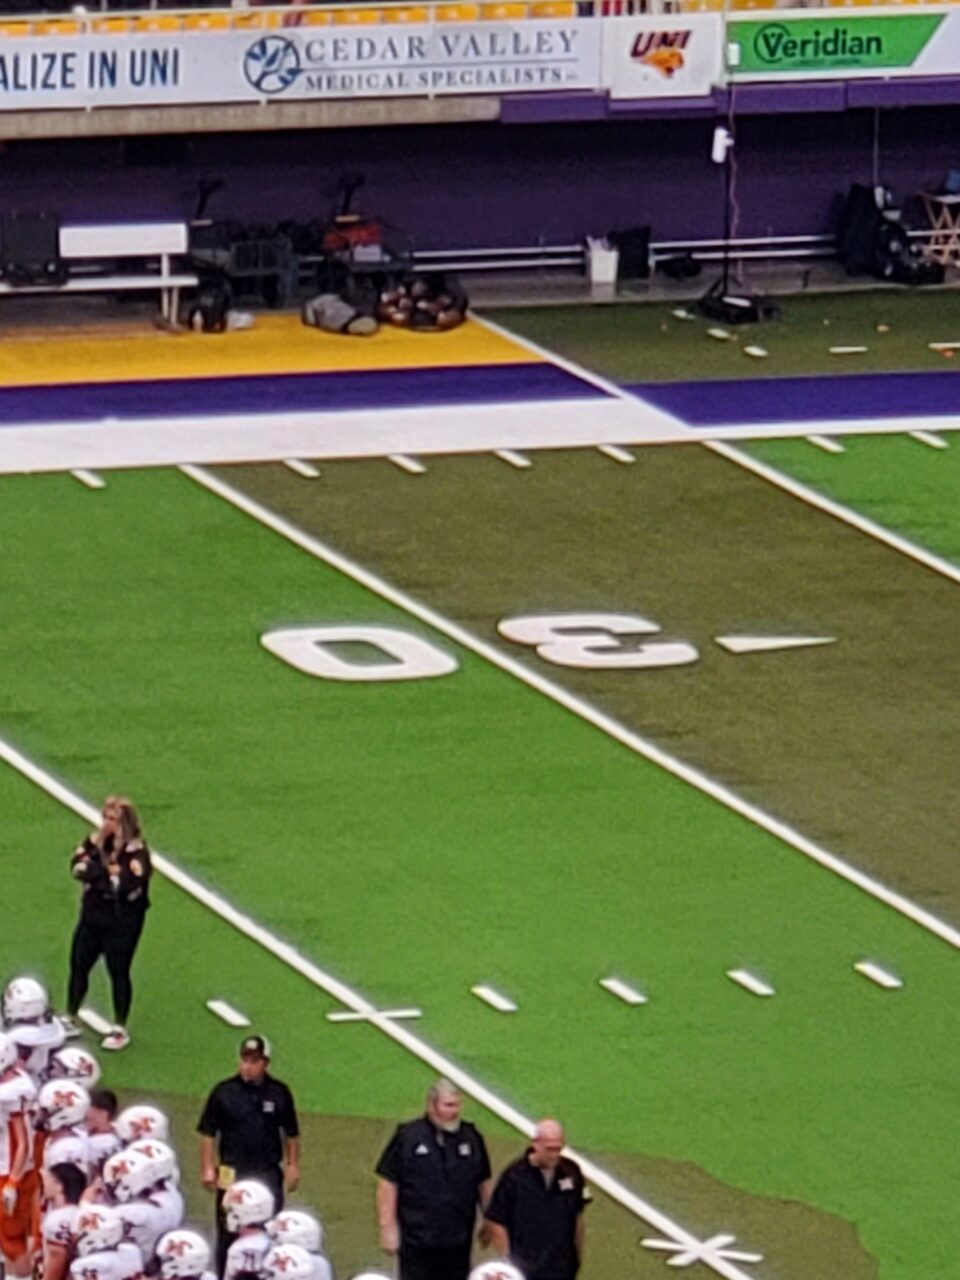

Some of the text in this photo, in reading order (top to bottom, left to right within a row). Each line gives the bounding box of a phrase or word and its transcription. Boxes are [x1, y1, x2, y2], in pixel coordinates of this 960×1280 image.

[304, 31, 578, 62] CEDAR VALLEY
[759, 30, 881, 60] Veridian
[87, 52, 118, 88] IN
[129, 50, 178, 87] UNI
[305, 68, 562, 92] MEDICAL SPECIALISTS
